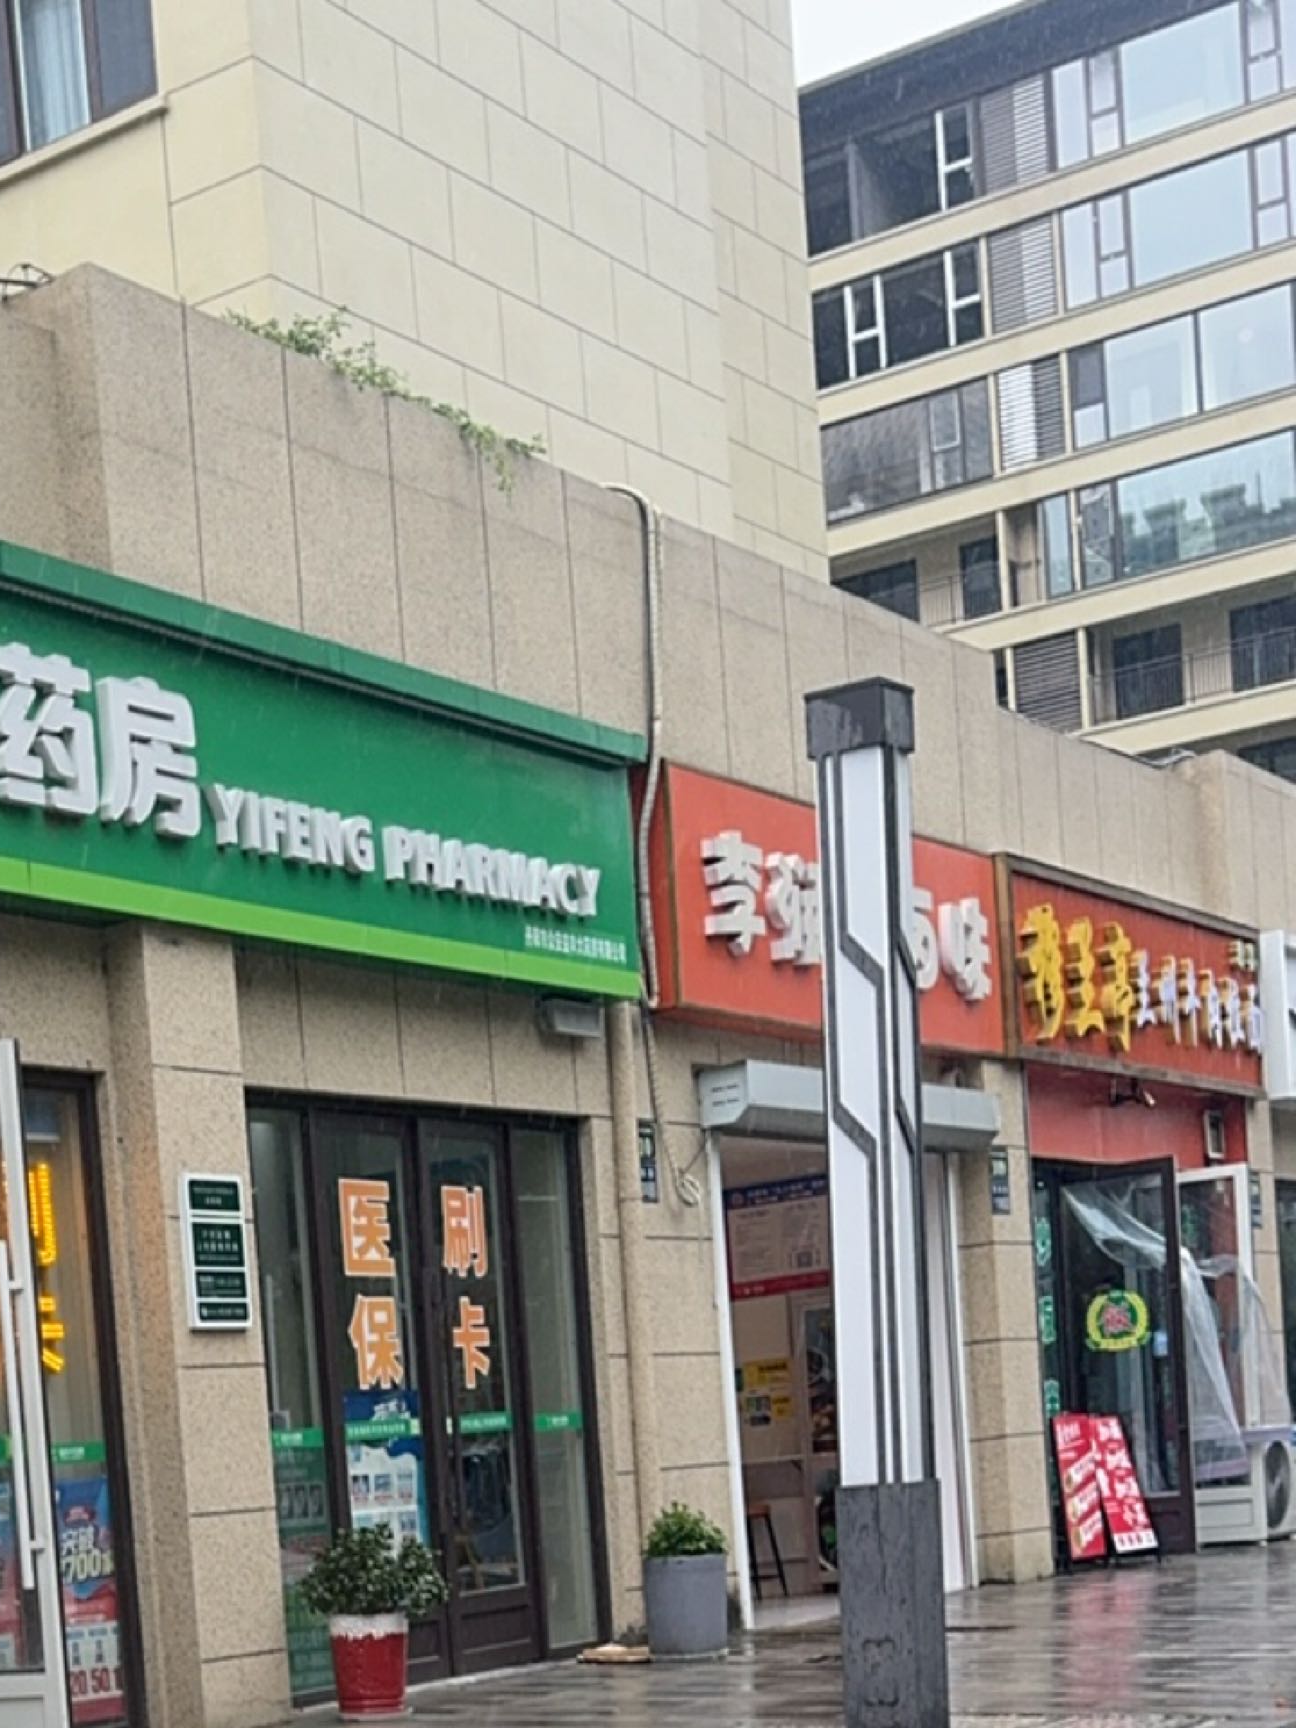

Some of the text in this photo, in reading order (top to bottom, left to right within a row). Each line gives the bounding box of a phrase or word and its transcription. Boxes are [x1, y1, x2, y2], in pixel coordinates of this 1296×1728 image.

[208, 783, 601, 916] YIFENG PHARMACY
[338, 1178, 403, 1391] 医保
[440, 1185, 492, 1389] 刷卡
